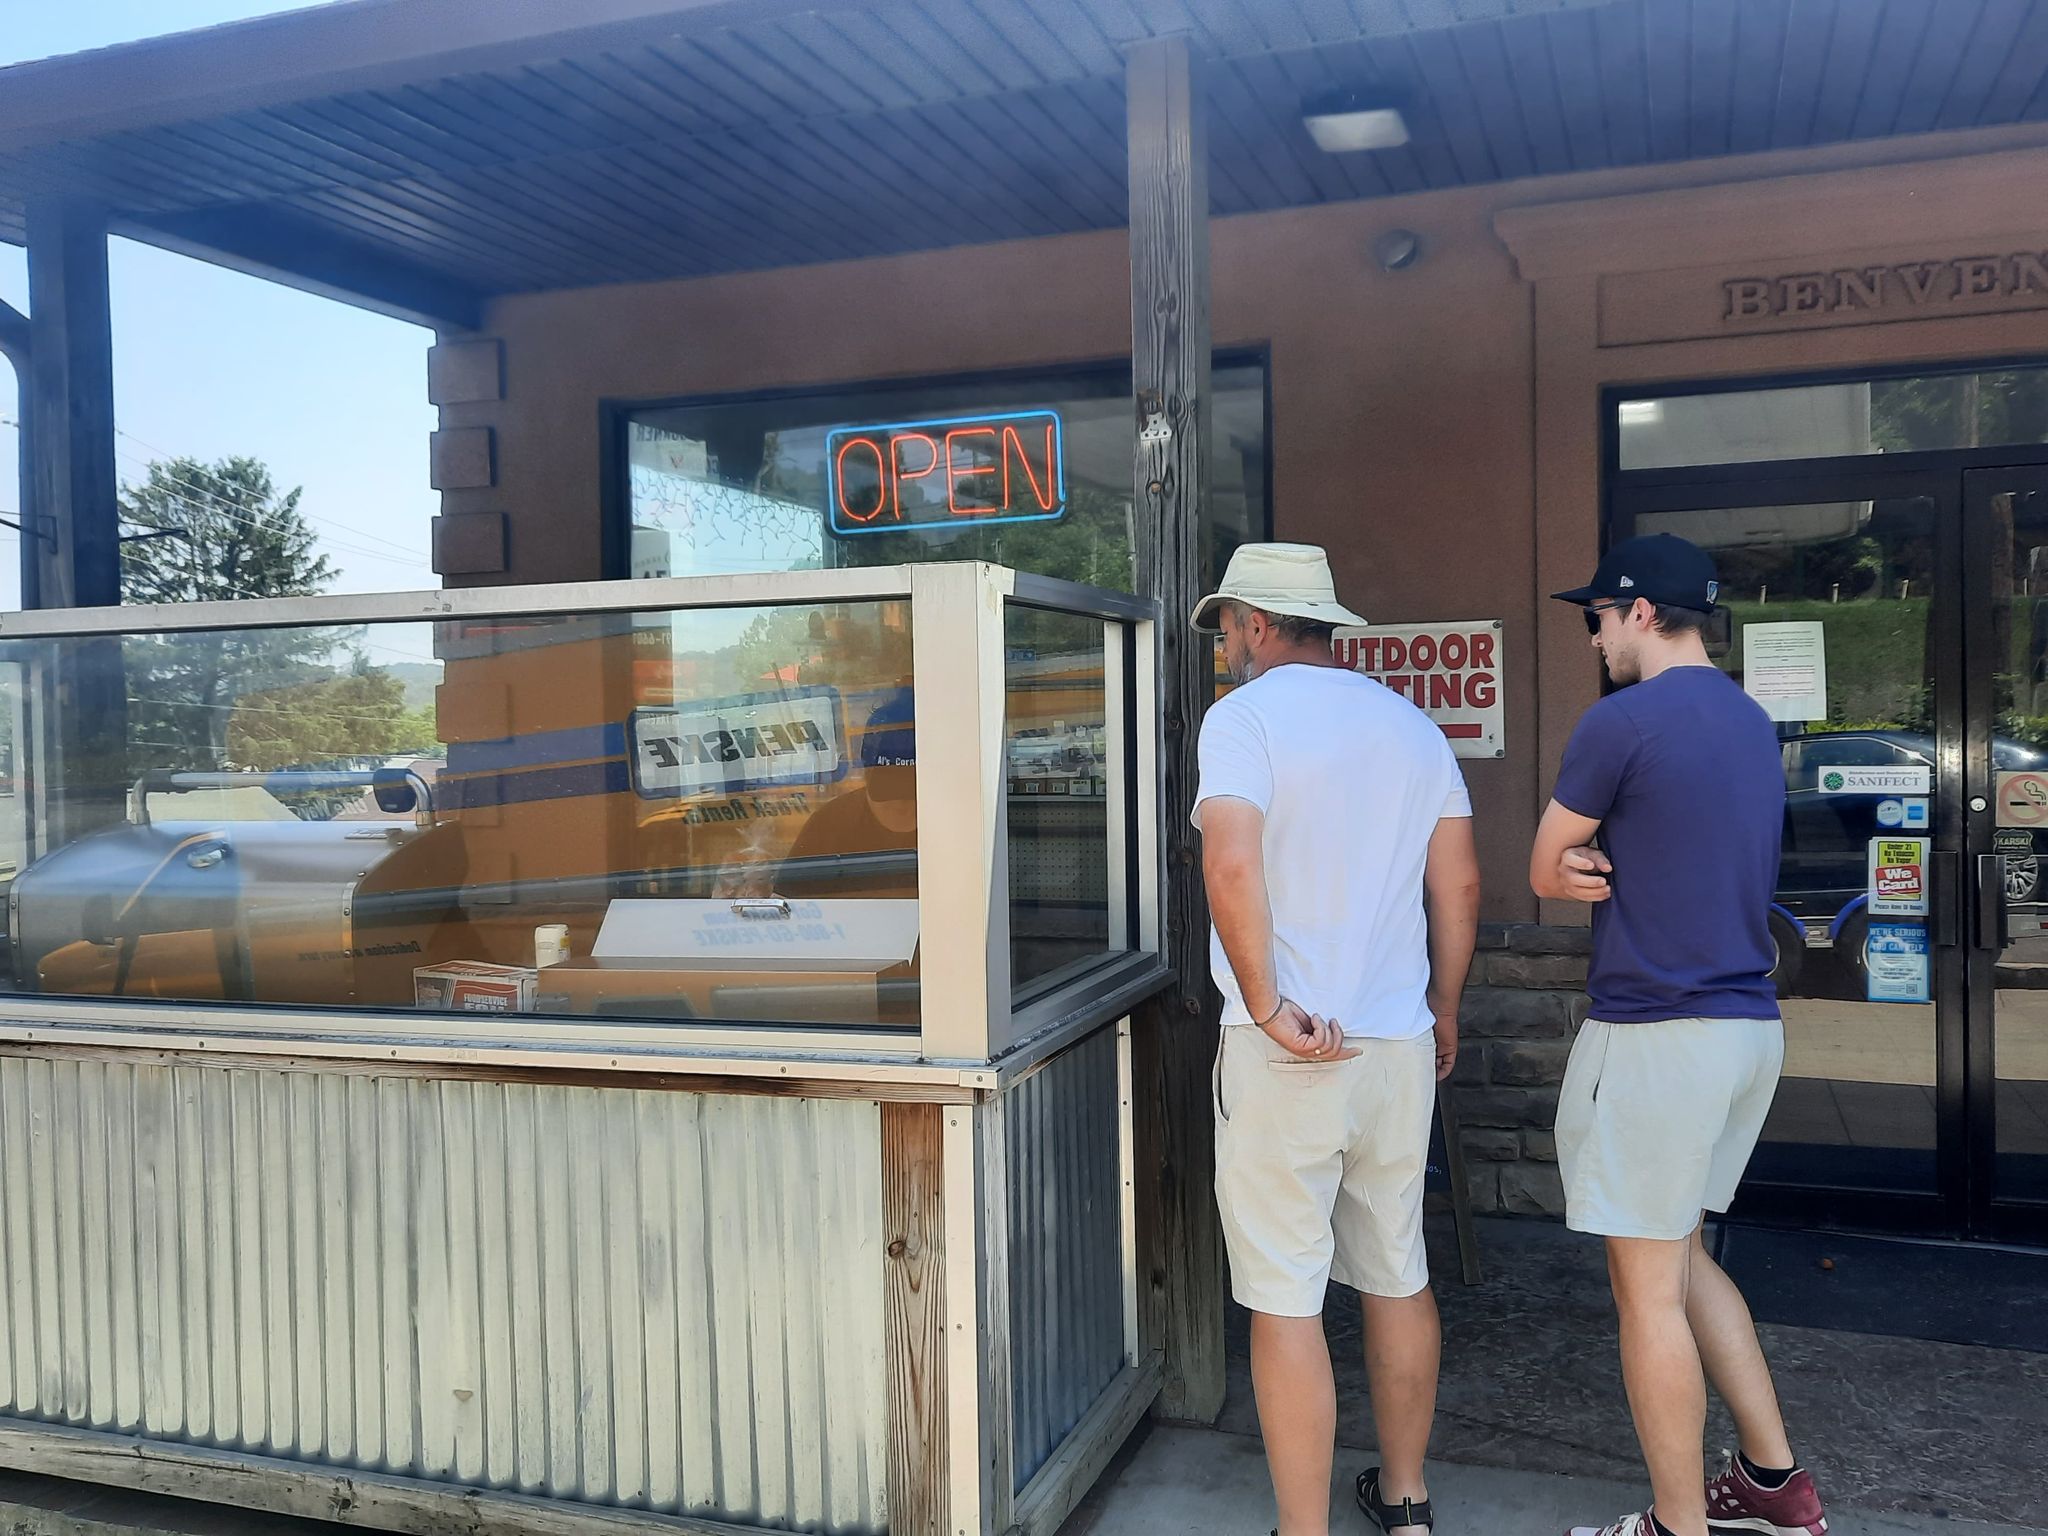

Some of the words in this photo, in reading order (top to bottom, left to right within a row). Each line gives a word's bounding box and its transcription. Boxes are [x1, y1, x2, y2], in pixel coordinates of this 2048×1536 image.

[835, 423, 1054, 522] OPEN
[1334, 633, 1495, 672] UTDOOR
[1367, 671, 1497, 709] TING
[877, 755, 891, 766] Al's
[895, 757, 915, 767] Corn
[1847, 776, 1922, 787] SANIFECT
[1884, 868, 1913, 880] We
[1878, 878, 1920, 891] Card
[1894, 928, 1926, 937] SERIOUS
